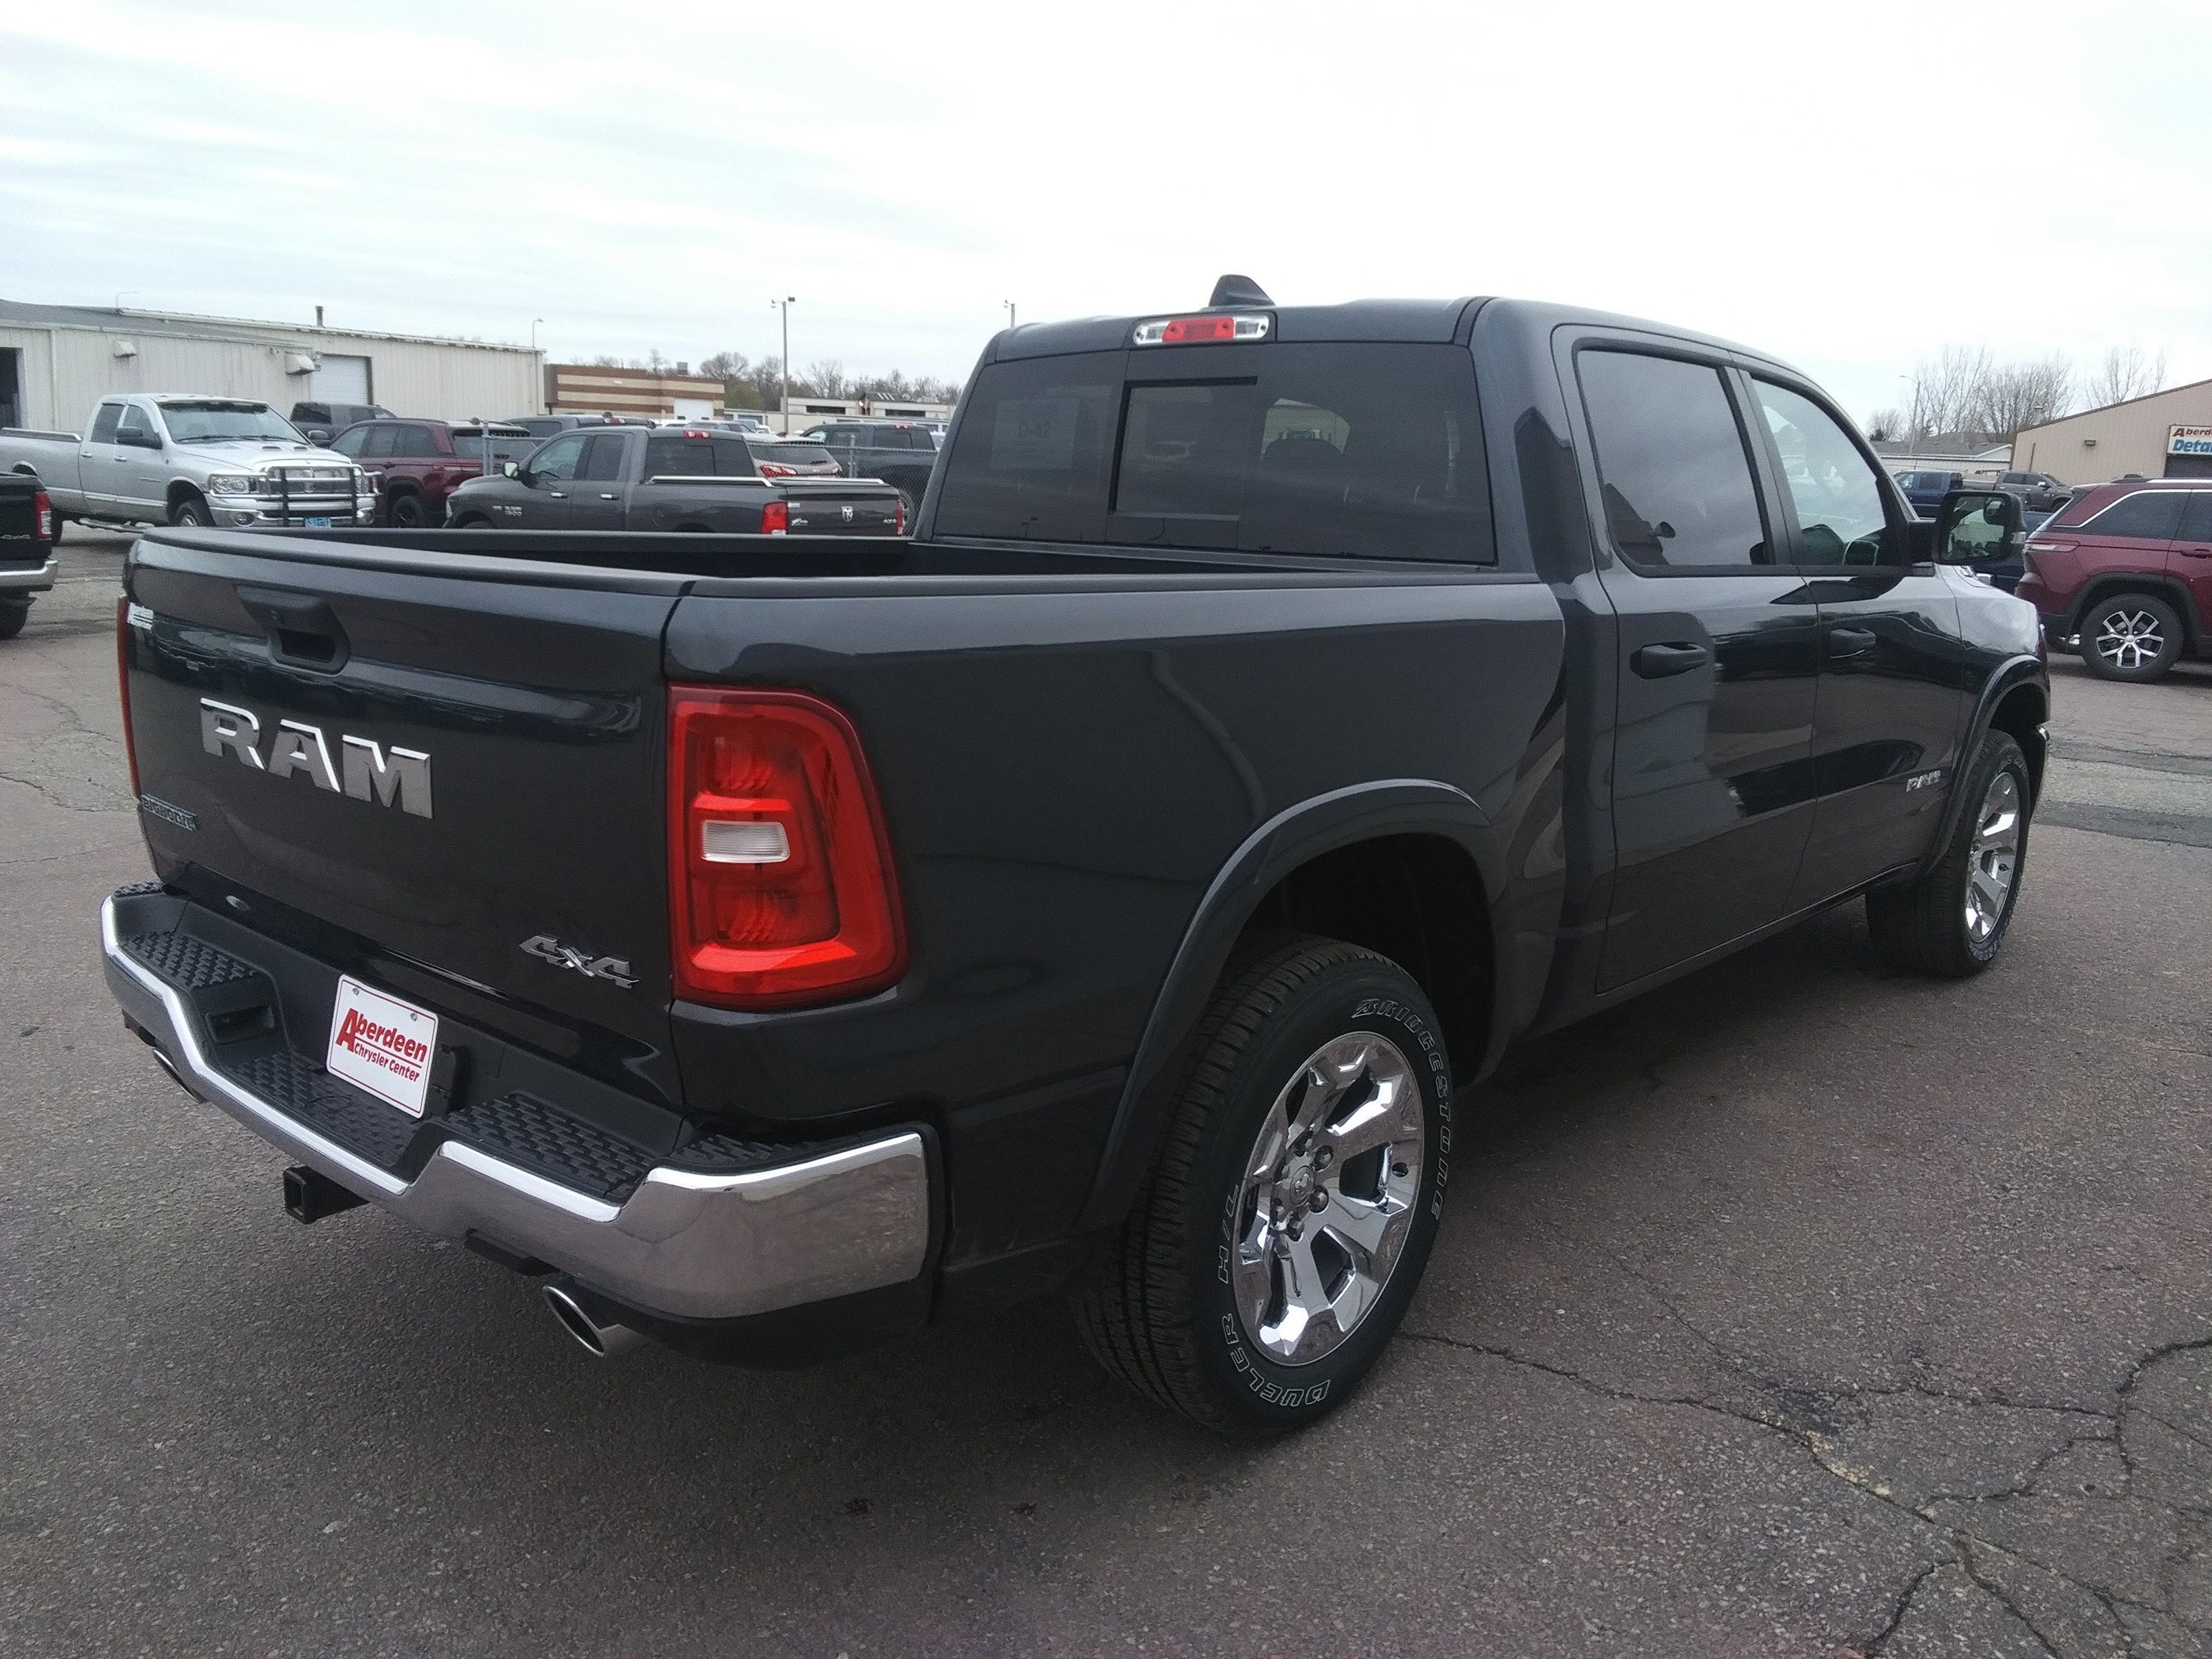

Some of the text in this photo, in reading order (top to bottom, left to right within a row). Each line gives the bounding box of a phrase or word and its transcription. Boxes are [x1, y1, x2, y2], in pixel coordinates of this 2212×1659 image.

[2172, 428, 2212, 437] Aberd
[200, 697, 433, 819] RAM
[1906, 769, 1942, 793] RAM
[335, 1007, 428, 1063] Aberdeen
[354, 1042, 420, 1083] Chrysler Center
[1351, 998, 1451, 1221] BRIDGESTONE
[1221, 1313, 1331, 1407] DUELER
